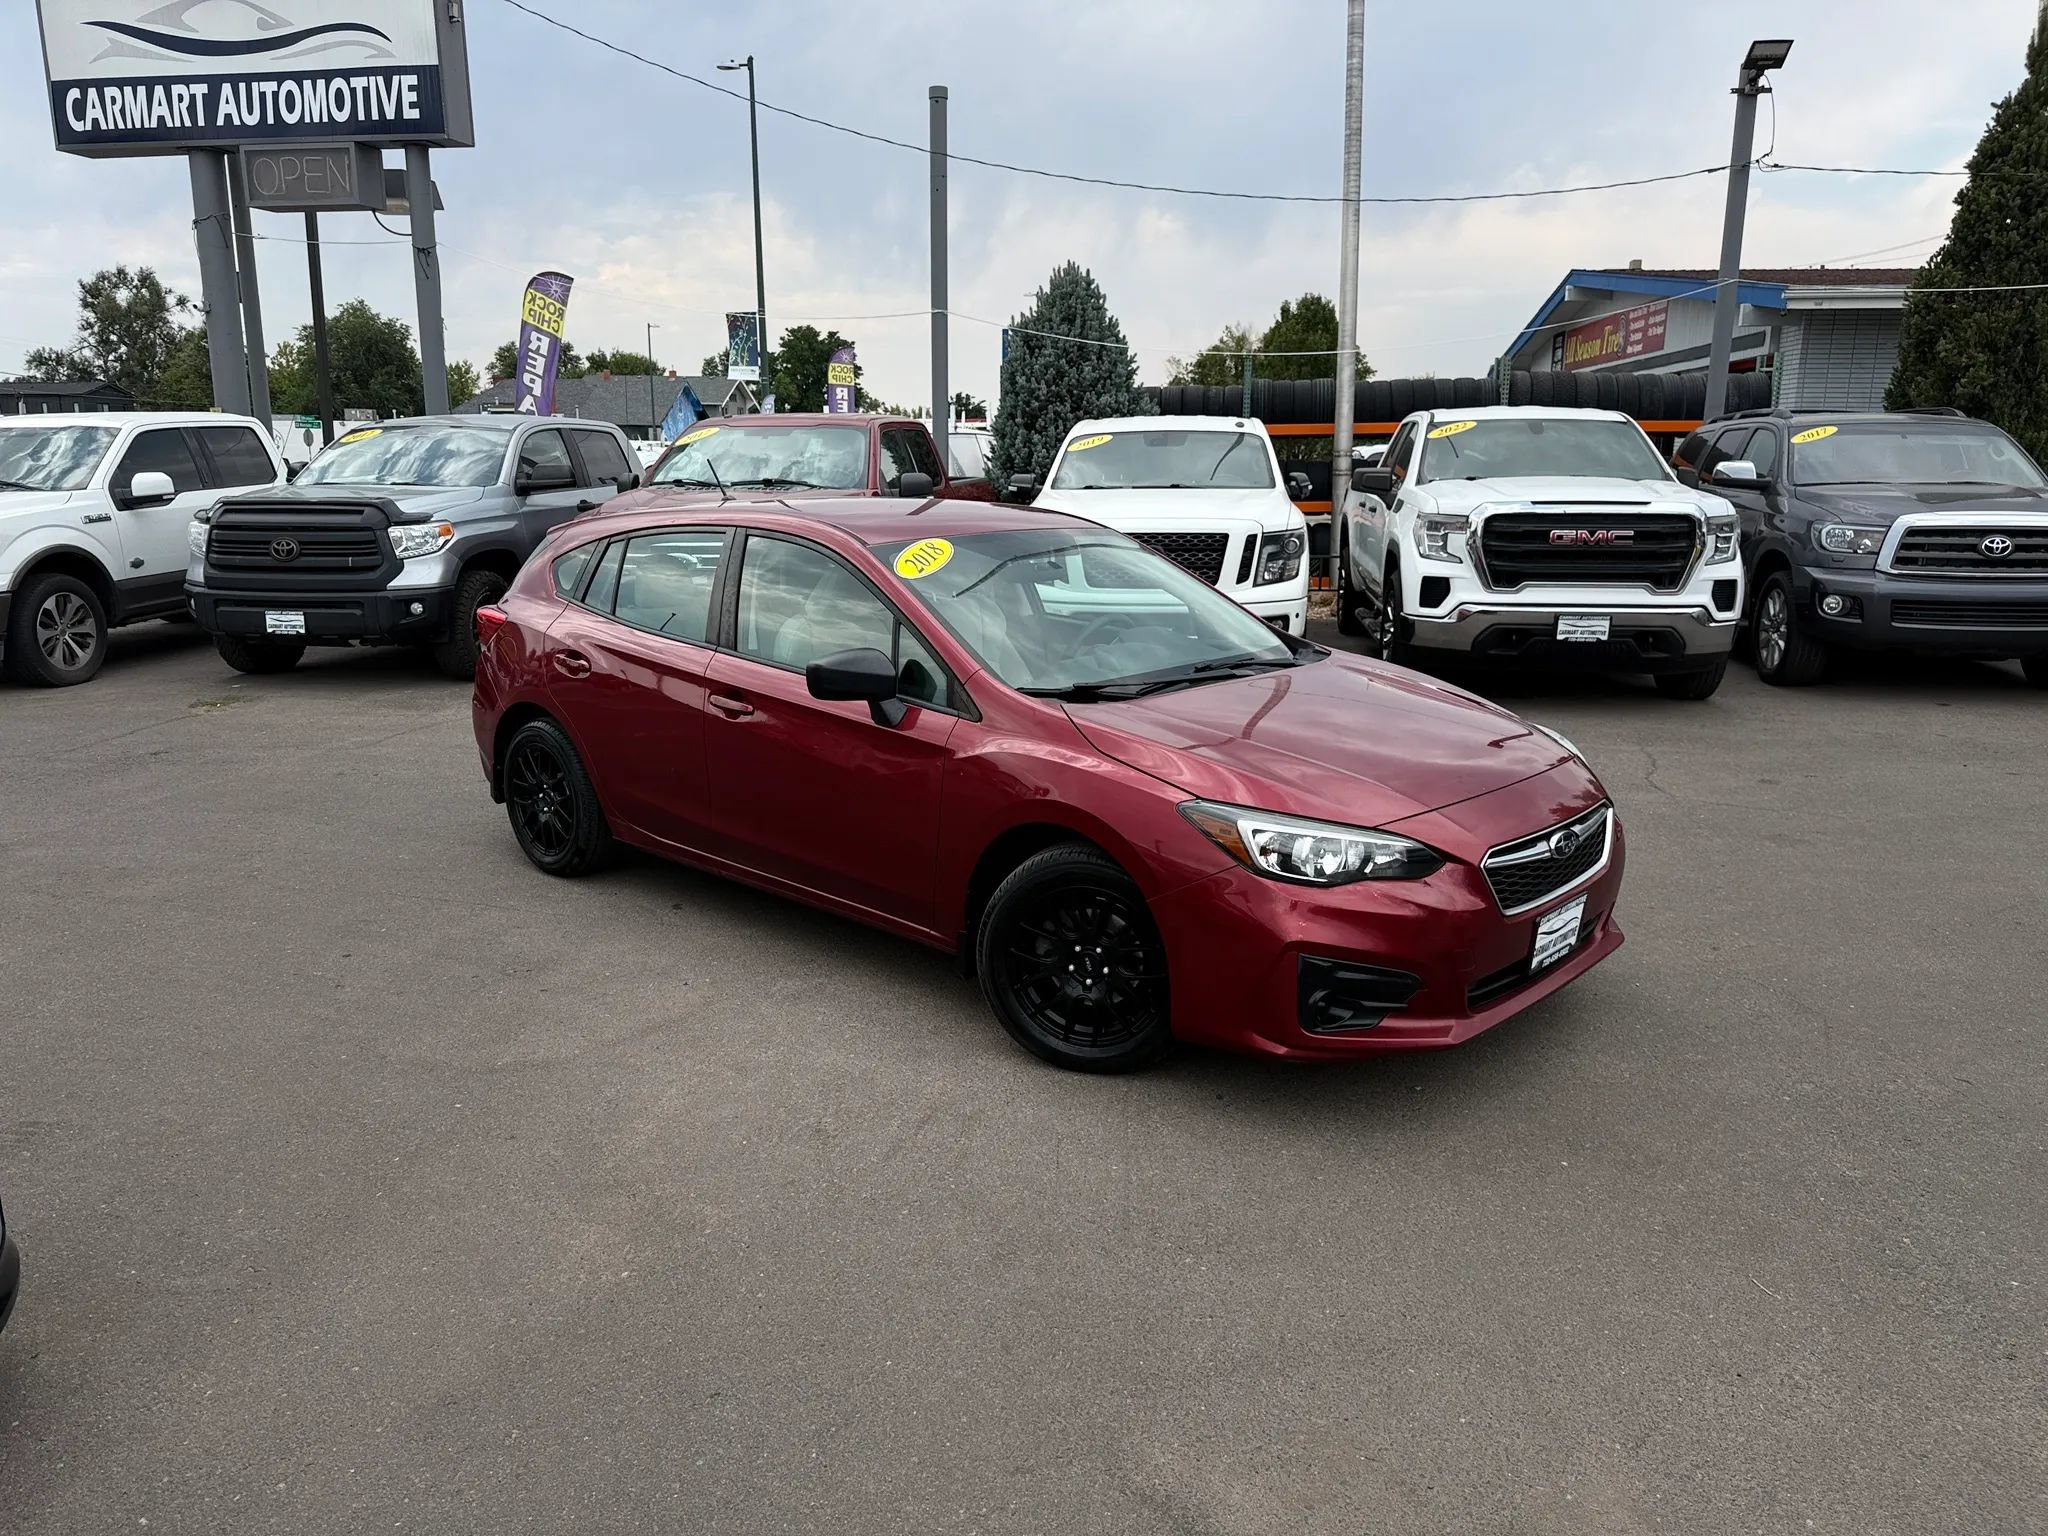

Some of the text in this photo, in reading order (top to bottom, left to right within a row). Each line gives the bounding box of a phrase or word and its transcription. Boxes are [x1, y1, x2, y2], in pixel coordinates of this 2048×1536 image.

[65, 74, 421, 132] CARMART AUTOMOTIVE
[252, 156, 350, 195] OPEN
[1575, 334, 1602, 362] Season
[1438, 422, 1468, 437] 2022
[1800, 427, 1827, 441] 2017
[1549, 529, 1635, 545] GMC
[904, 541, 945, 574] 2018
[1578, 629, 1607, 637] AUTOMOTIVE
